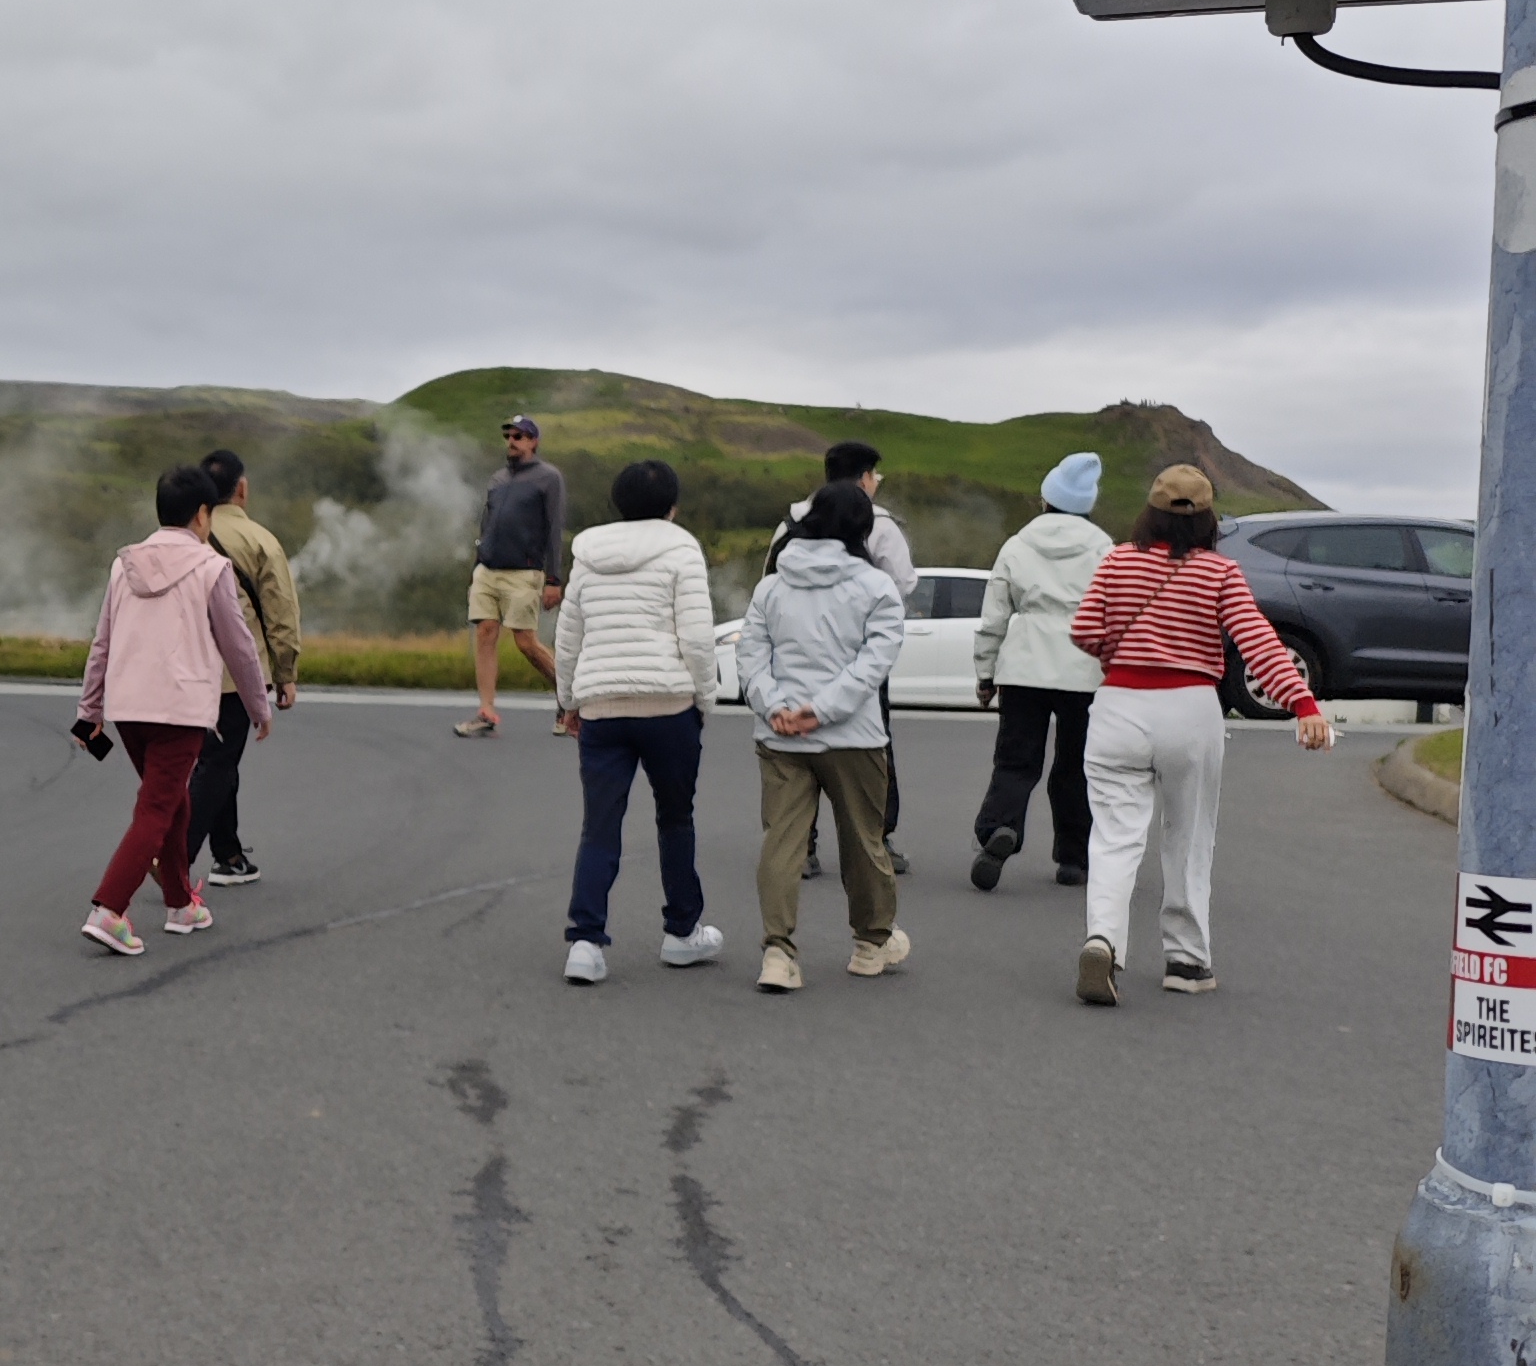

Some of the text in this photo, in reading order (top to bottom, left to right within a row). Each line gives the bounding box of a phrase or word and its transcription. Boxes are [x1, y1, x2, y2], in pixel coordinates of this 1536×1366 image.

[1483, 956, 1508, 985] FC
[1476, 996, 1510, 1023] THE
[1456, 1019, 1536, 1055] SPIREITE
